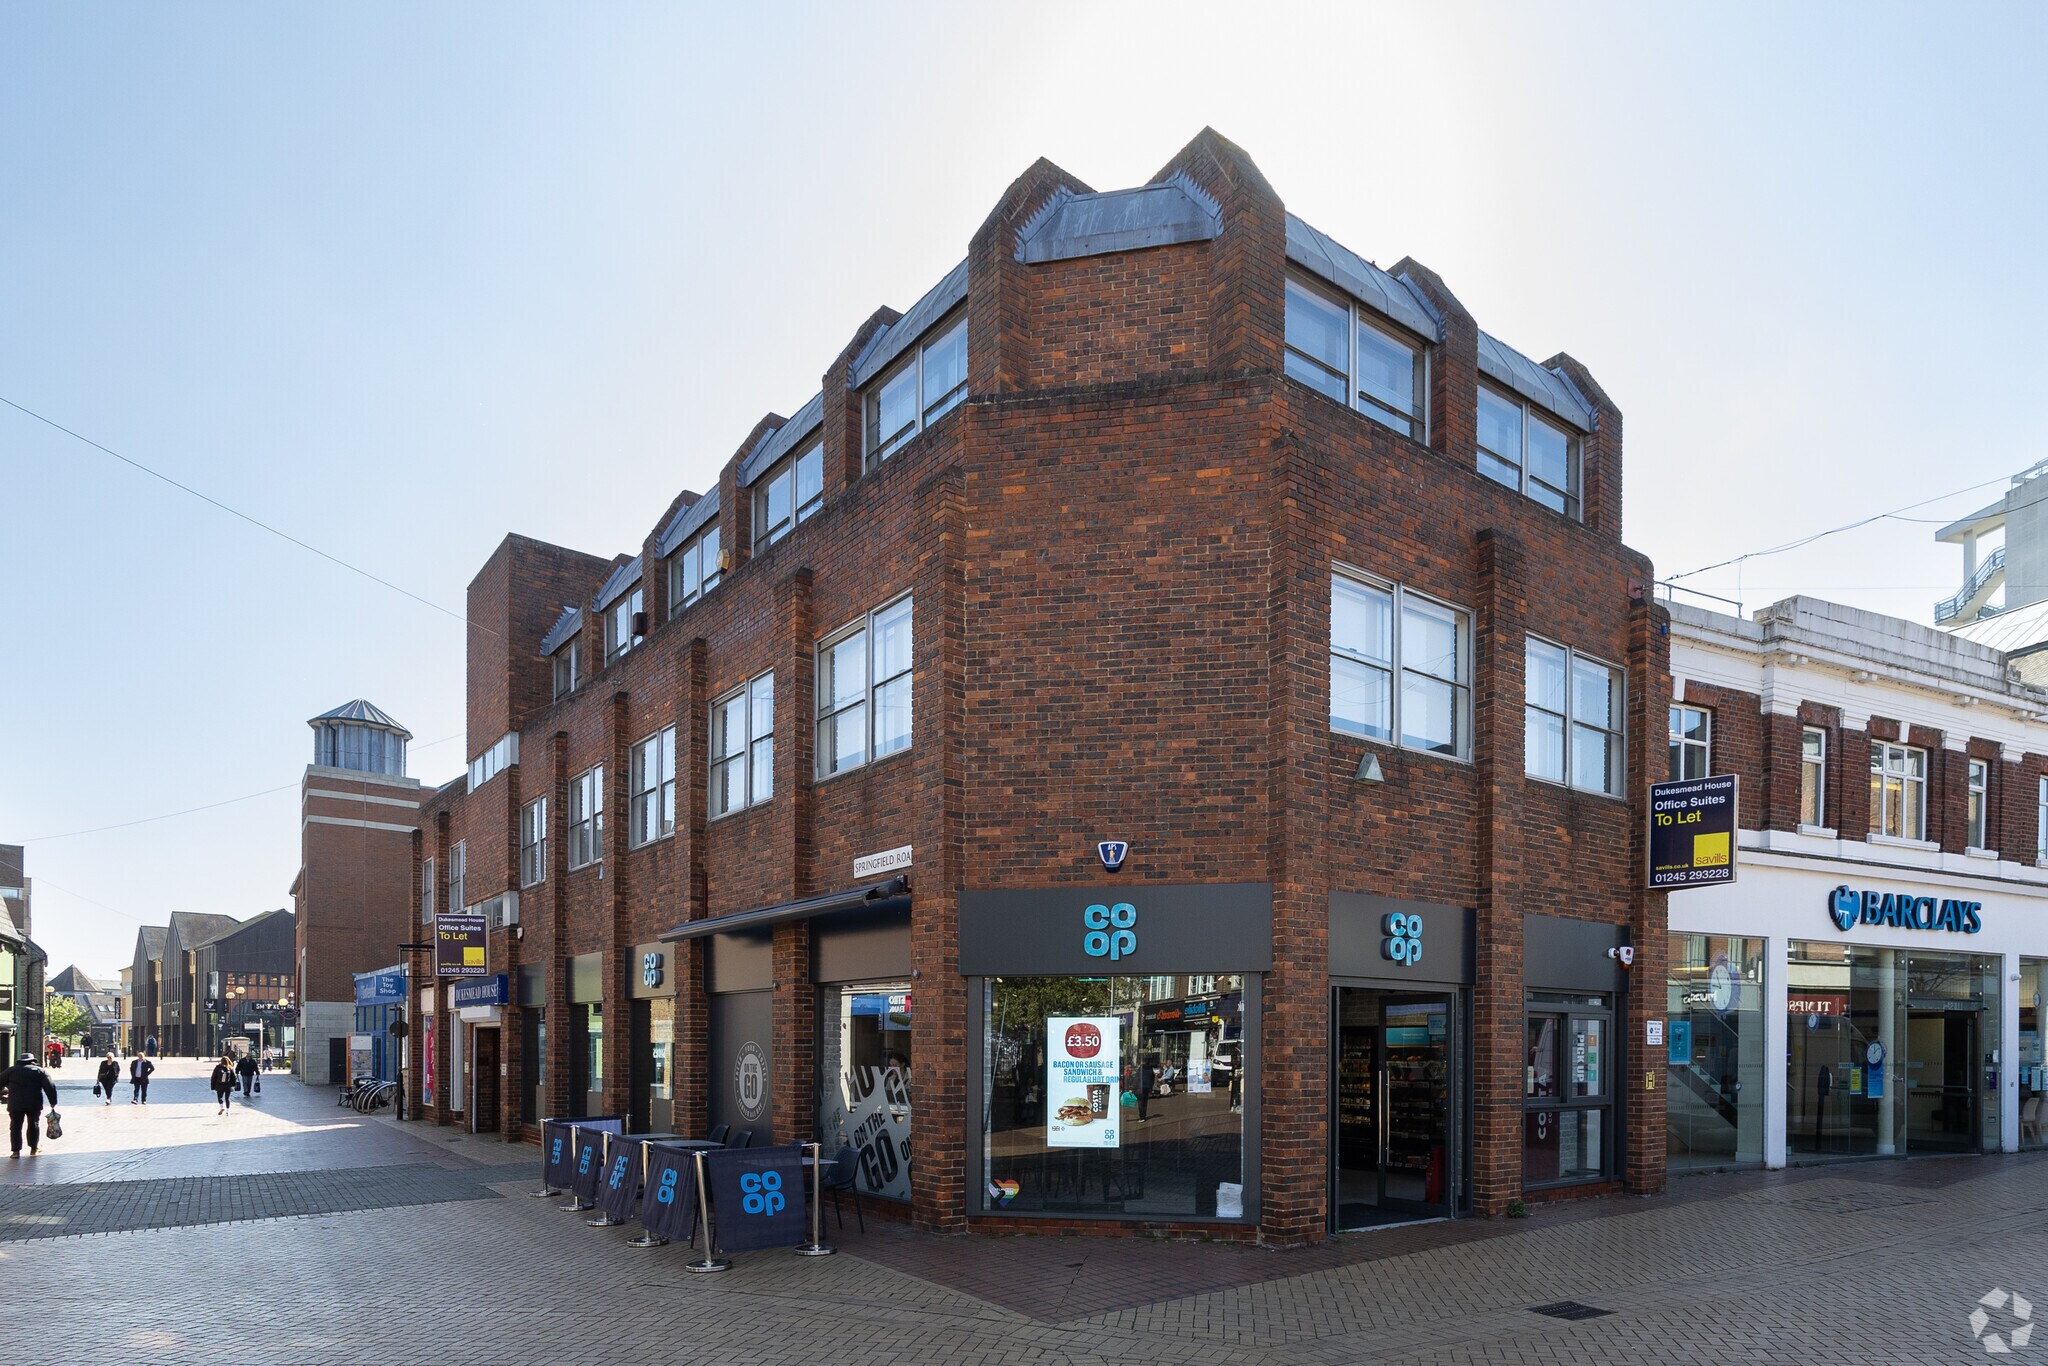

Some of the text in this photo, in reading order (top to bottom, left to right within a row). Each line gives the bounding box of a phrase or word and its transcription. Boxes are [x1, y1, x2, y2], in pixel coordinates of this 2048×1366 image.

[1655, 781, 1732, 796] Dukesmead House
[1655, 796, 1726, 810] Office Suites
[1655, 810, 1702, 826] To Let
[855, 855, 894, 873] SPRINGFIELD
[1695, 853, 1727, 865] savills
[1655, 868, 1729, 882] 01245 293228
[1860, 890, 1982, 934] BARCLAYS
[439, 932, 468, 940] To Let
[482, 984, 497, 998] HOUSE
[1067, 1034, 1100, 1047] £3.50
[1053, 1060, 1114, 1068] BACON OR SAUSAGE
[1576, 1034, 1584, 1082] PICK UP
[744, 1064, 758, 1073] ON THE
[1064, 1068, 1097, 1076] SANDWICH
[744, 1074, 758, 1100] GO
[1092, 1076, 1105, 1084] HOT
[854, 1112, 886, 1148] ON THE
[860, 1128, 898, 1192] GO
